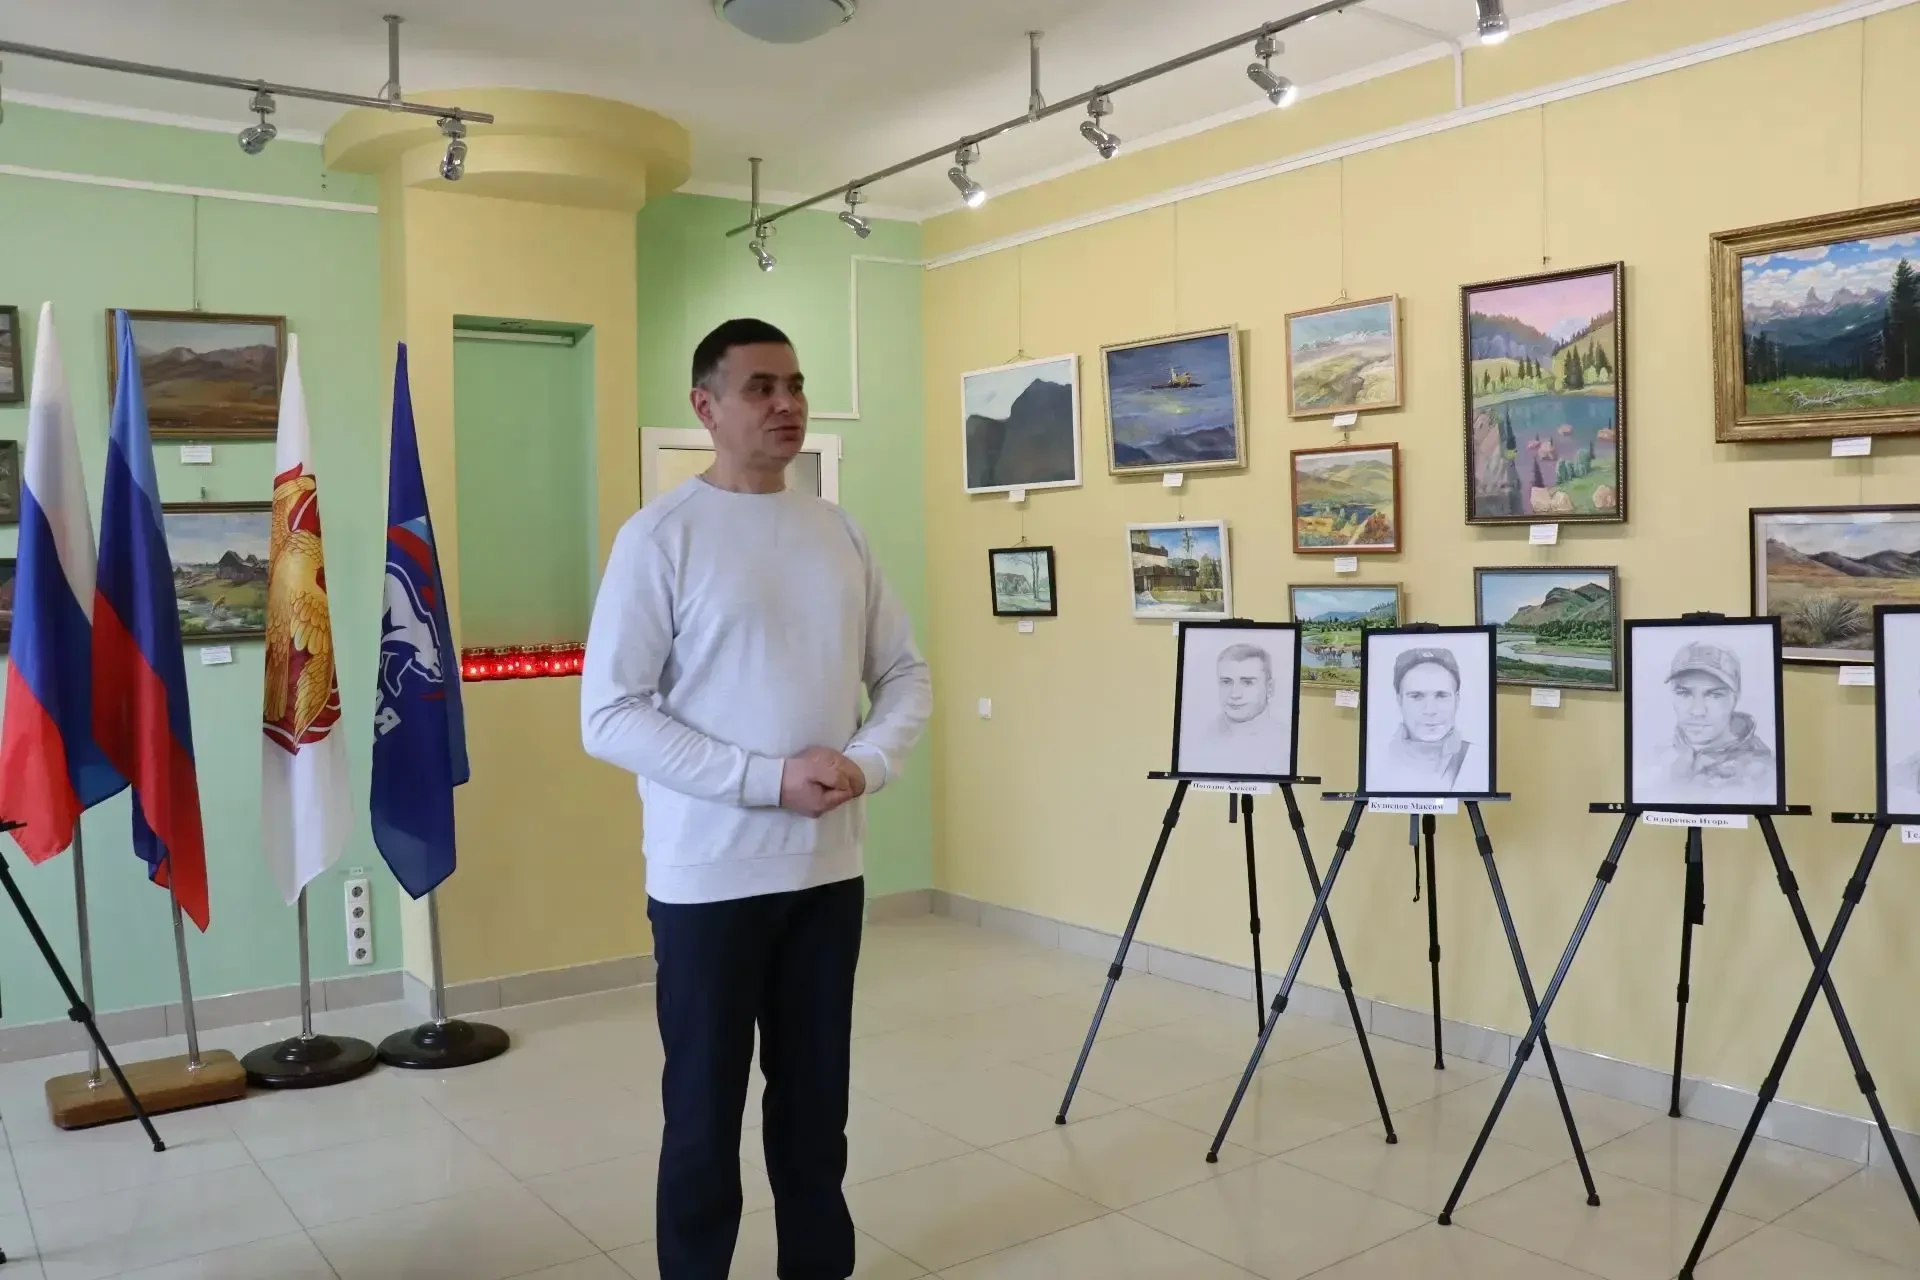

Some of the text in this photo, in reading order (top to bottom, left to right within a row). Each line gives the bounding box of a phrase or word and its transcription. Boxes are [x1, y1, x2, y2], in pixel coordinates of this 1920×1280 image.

[1226, 784, 1258, 792] Алексей
[1371, 801, 1444, 811] Кузнецов Максим
[1645, 813, 1730, 826] Сидоренко Игорь
